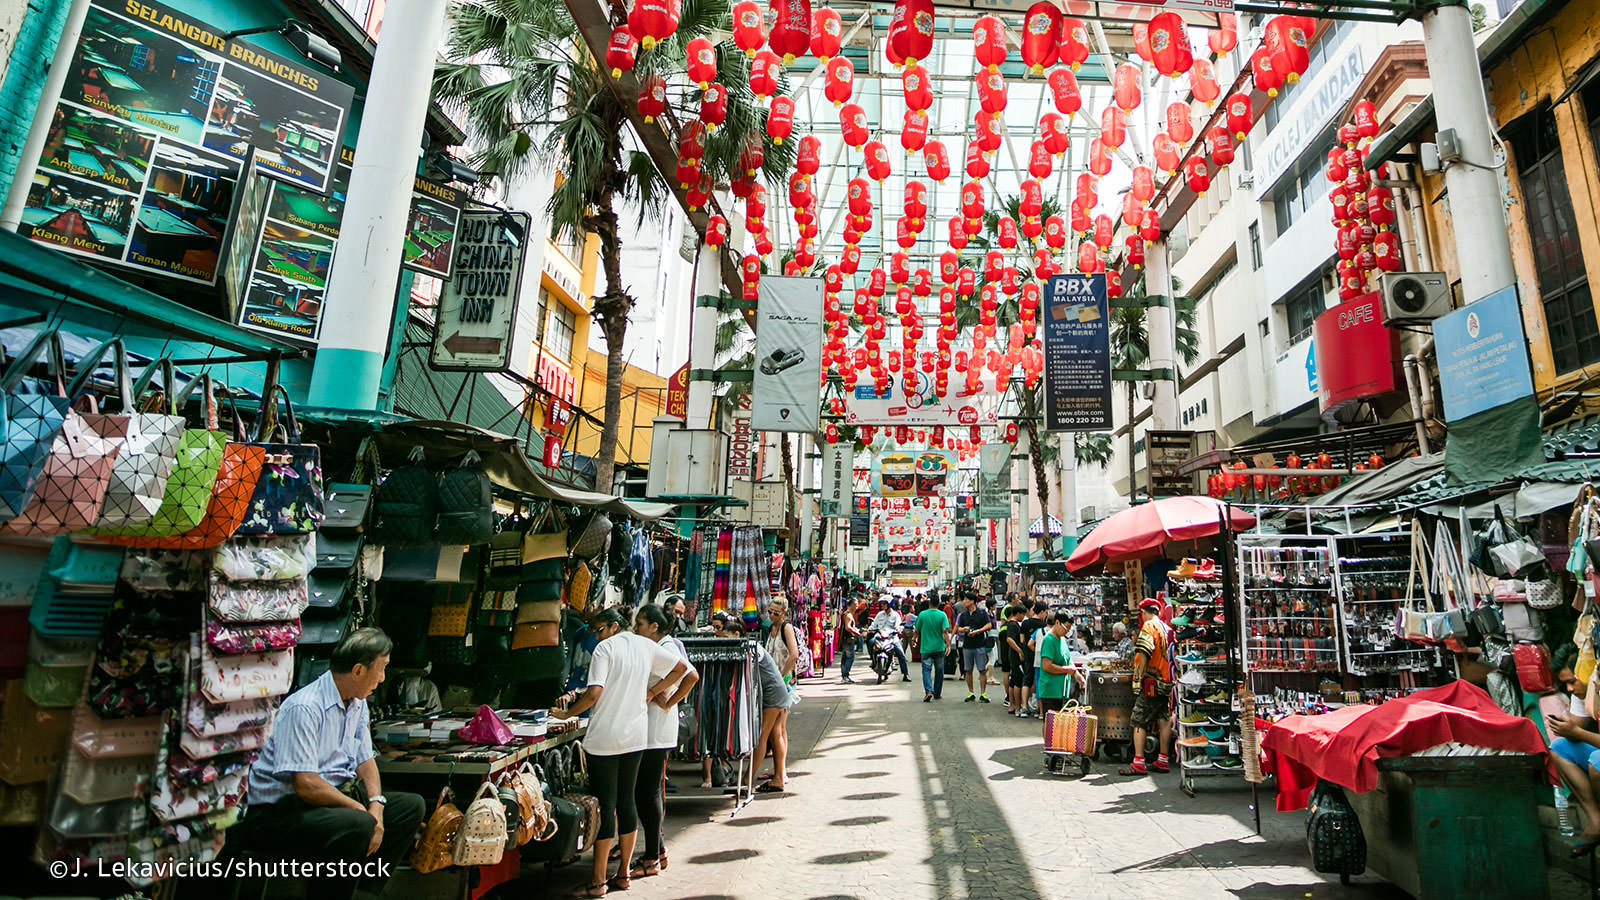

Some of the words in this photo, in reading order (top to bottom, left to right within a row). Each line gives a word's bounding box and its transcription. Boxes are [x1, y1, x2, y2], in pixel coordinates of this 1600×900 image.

[126, 0, 226, 51] SELANGOR
[230, 43, 319, 92] BRANCHES
[83, 94, 132, 118] Sunway
[135, 112, 180, 134] Mentari
[1267, 120, 1300, 176] KOLEJ
[1302, 51, 1360, 136] BANDAR
[50, 157, 99, 177] Amcorp
[103, 172, 129, 186] Mall
[287, 214, 316, 229] Subang
[32, 227, 69, 244] Klang
[73, 237, 105, 252] Meru
[131, 251, 167, 267] Taman
[170, 261, 211, 279] Mayang
[456, 245, 513, 270] CHINA
[266, 264, 290, 276] Salak
[292, 271, 317, 283] South
[456, 271, 511, 297] TOWN
[1054, 278, 1095, 295] BBX
[459, 297, 495, 323] INN
[1338, 303, 1374, 330] CAFE
[247, 314, 263, 324] Old
[264, 317, 288, 330] Klang
[290, 324, 312, 335] Road
